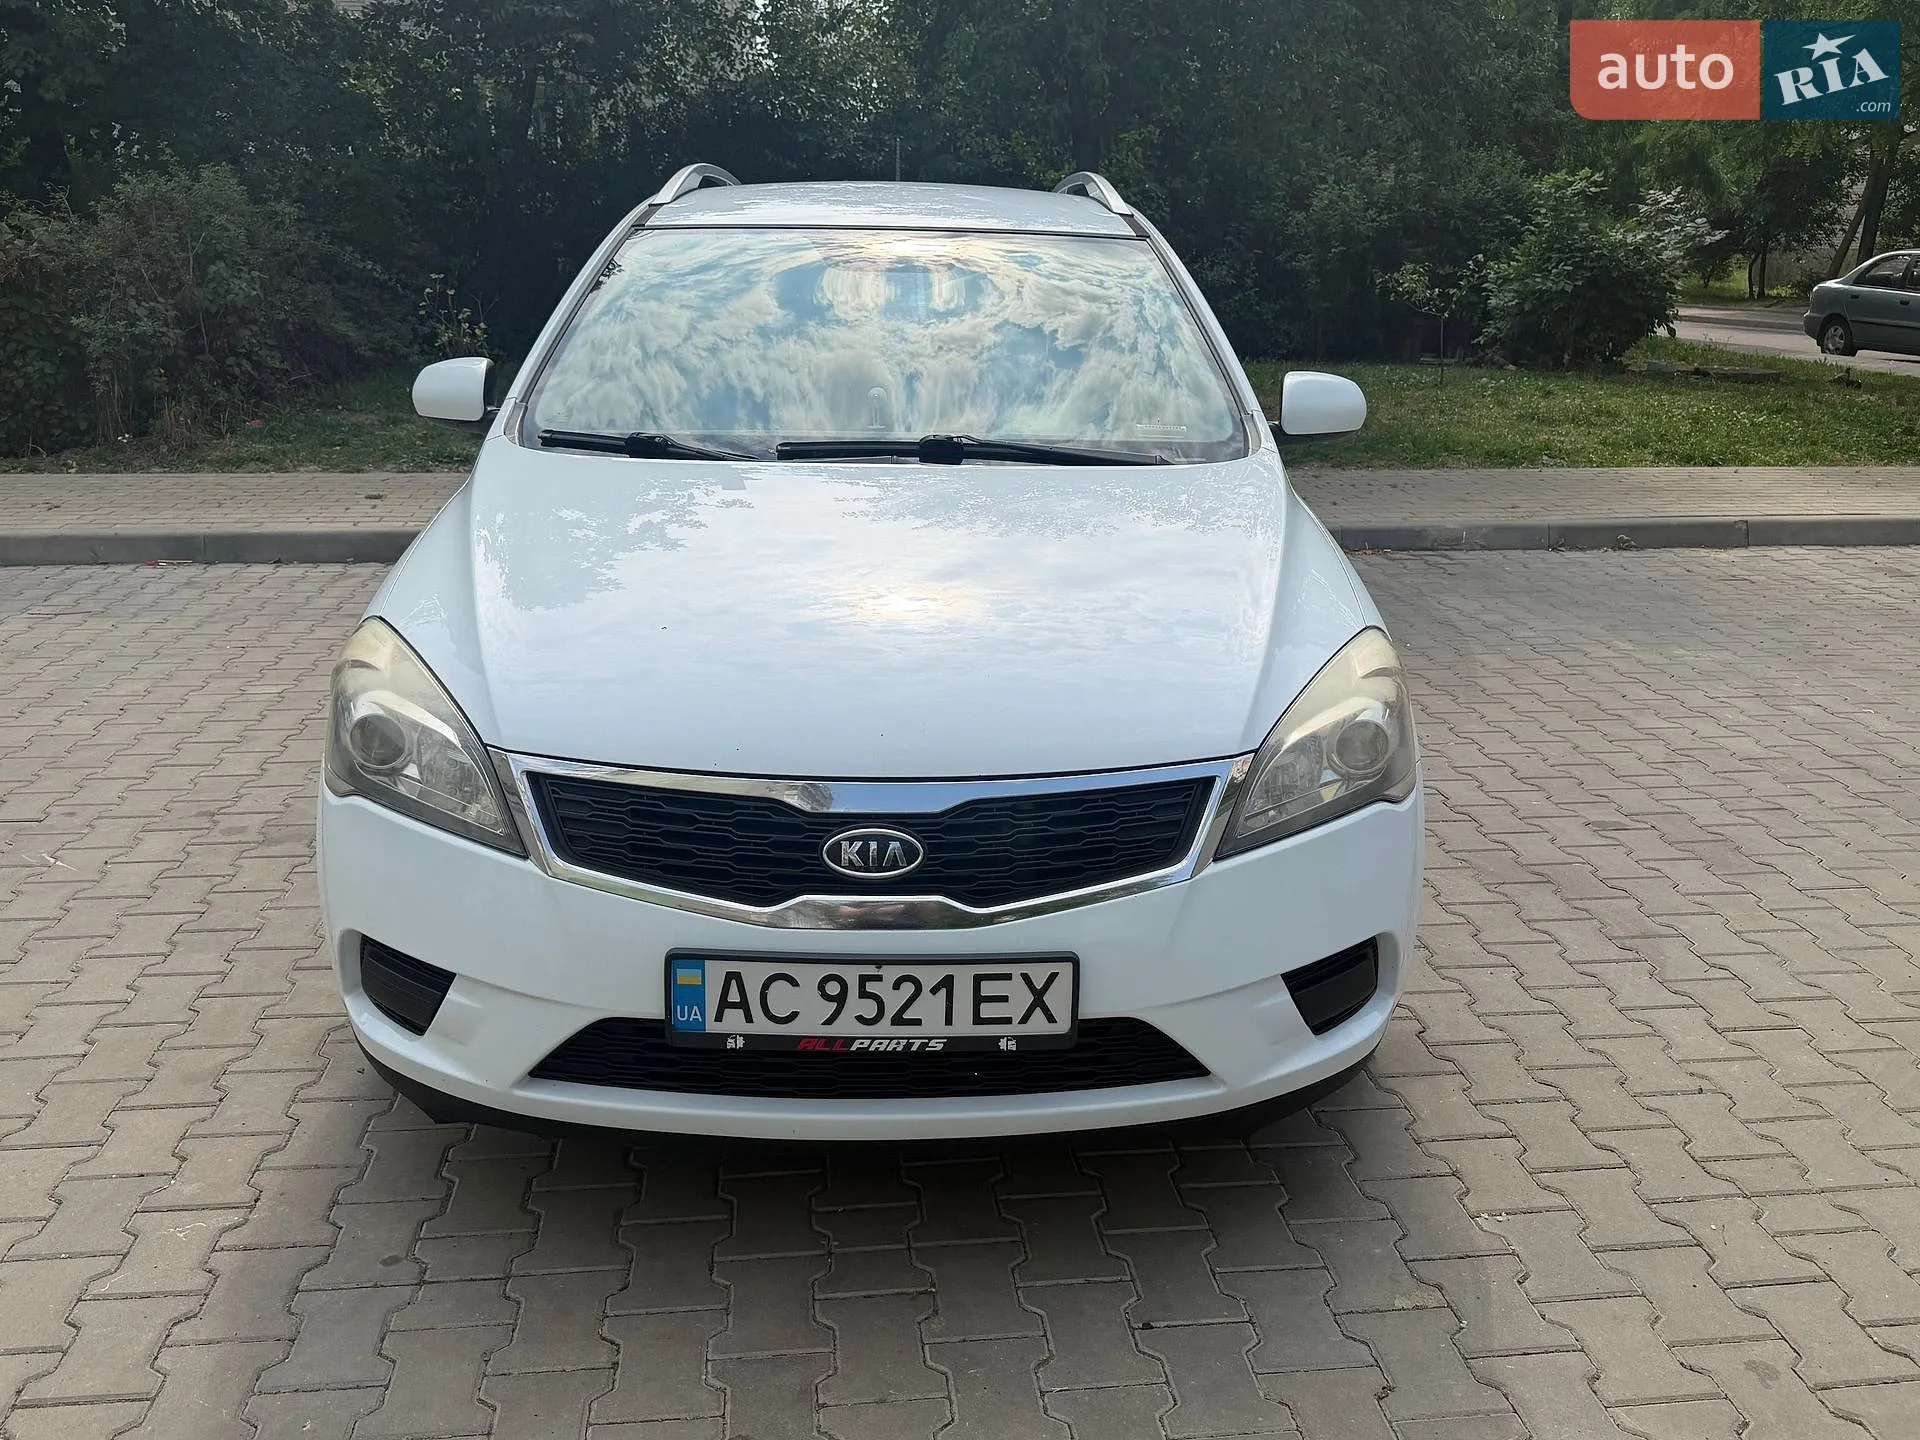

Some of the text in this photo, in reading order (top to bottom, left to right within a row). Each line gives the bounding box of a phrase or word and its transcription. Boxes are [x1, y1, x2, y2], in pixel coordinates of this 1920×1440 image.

[840, 840, 908, 867] KIA
[714, 971, 1059, 1027] AC 9521 EX
[677, 1006, 702, 1023] UA
[797, 1038, 948, 1052] ALLPARTS
